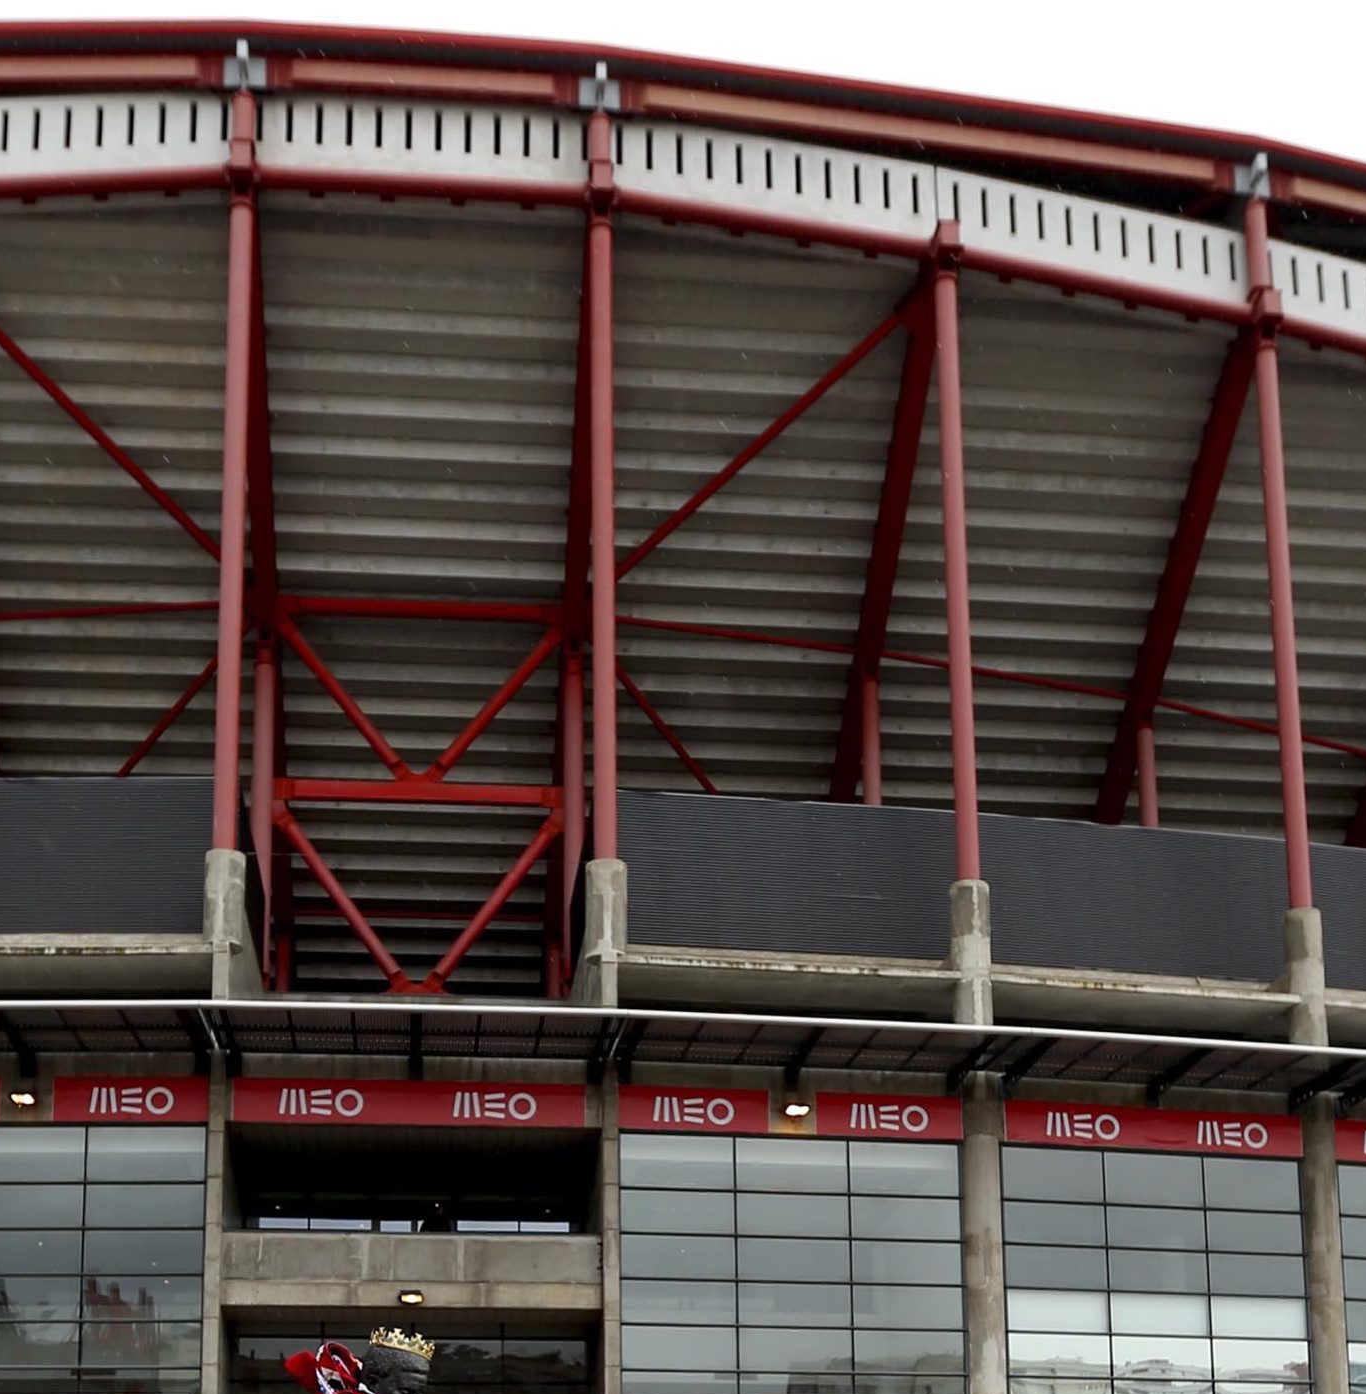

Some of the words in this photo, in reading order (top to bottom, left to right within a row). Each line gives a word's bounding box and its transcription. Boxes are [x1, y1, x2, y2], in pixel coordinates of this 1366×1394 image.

[88, 1085, 174, 1115] MEO
[279, 1088, 364, 1117] MEO
[452, 1091, 537, 1121] MEO
[653, 1095, 735, 1125] MEO
[850, 1102, 930, 1133] MEO
[1045, 1111, 1122, 1142] MEO
[1196, 1120, 1270, 1150] MEO
